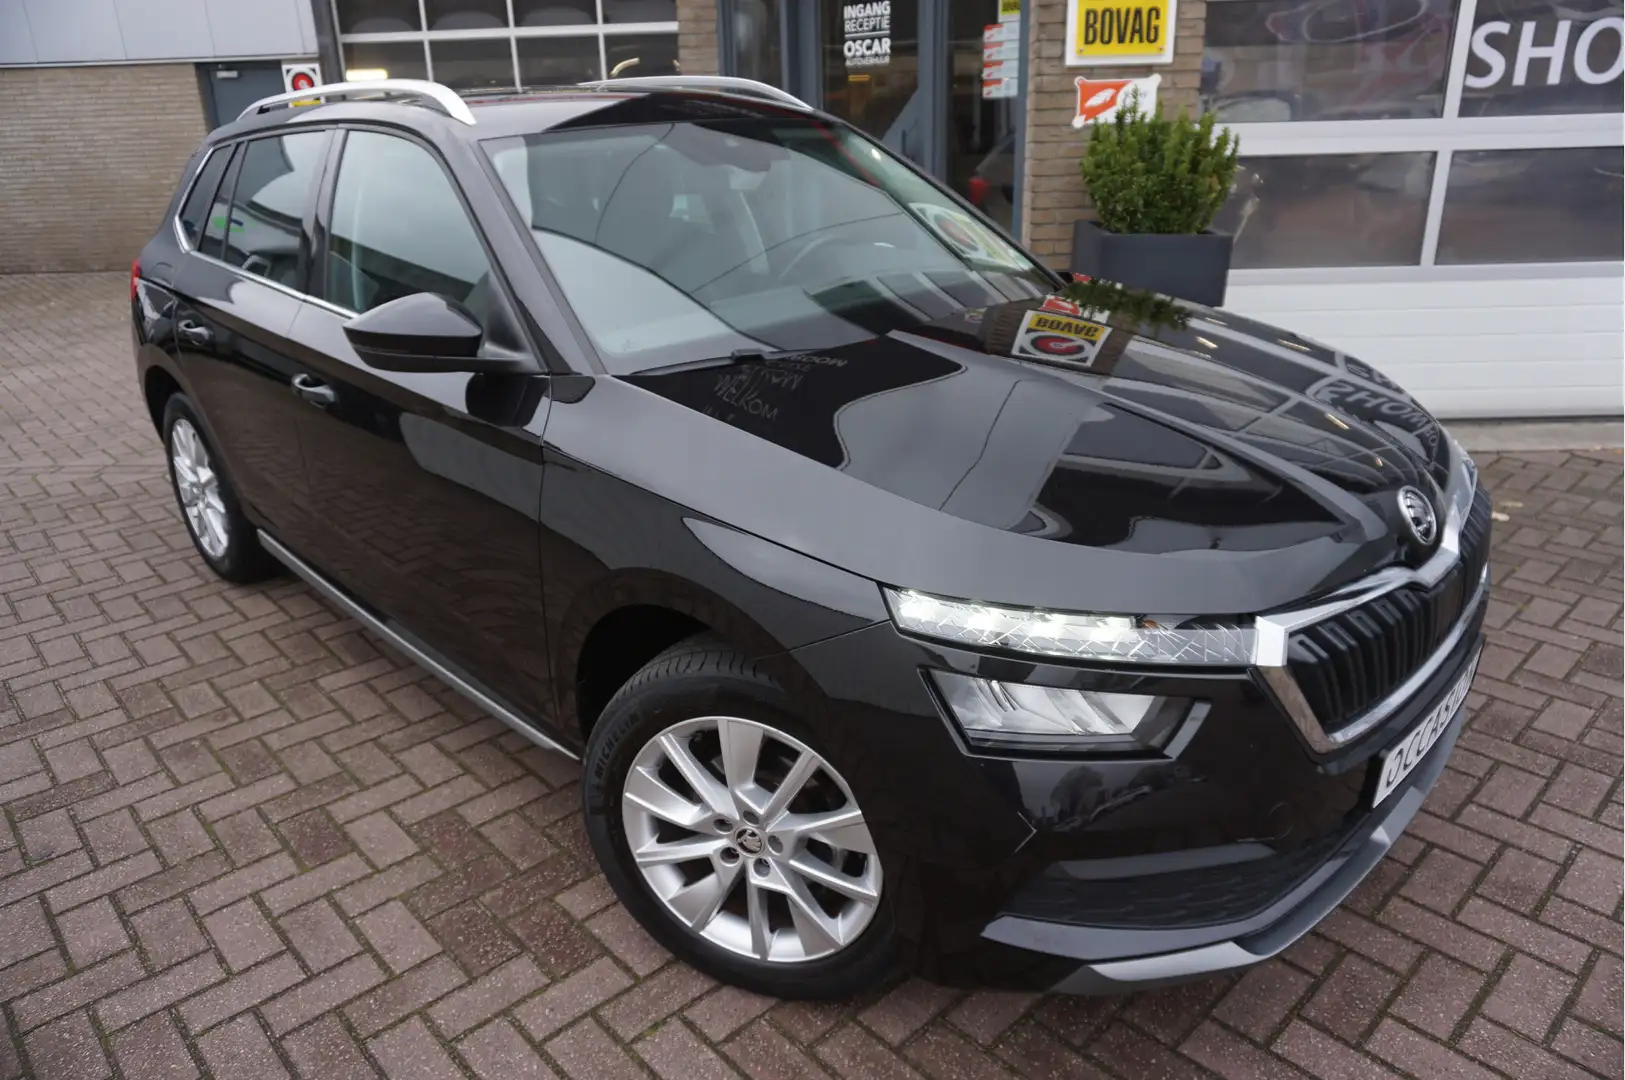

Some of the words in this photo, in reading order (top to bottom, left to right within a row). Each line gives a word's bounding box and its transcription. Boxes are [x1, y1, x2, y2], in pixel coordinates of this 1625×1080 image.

[844, 1, 891, 18] INGANG
[844, 16, 890, 32] RECEPTIE
[1084, 7, 1161, 45] BOVAG
[844, 38, 891, 57] OSCAR
[1464, 17, 1624, 89] SHO
[594, 709, 640, 777] MICHELIN
